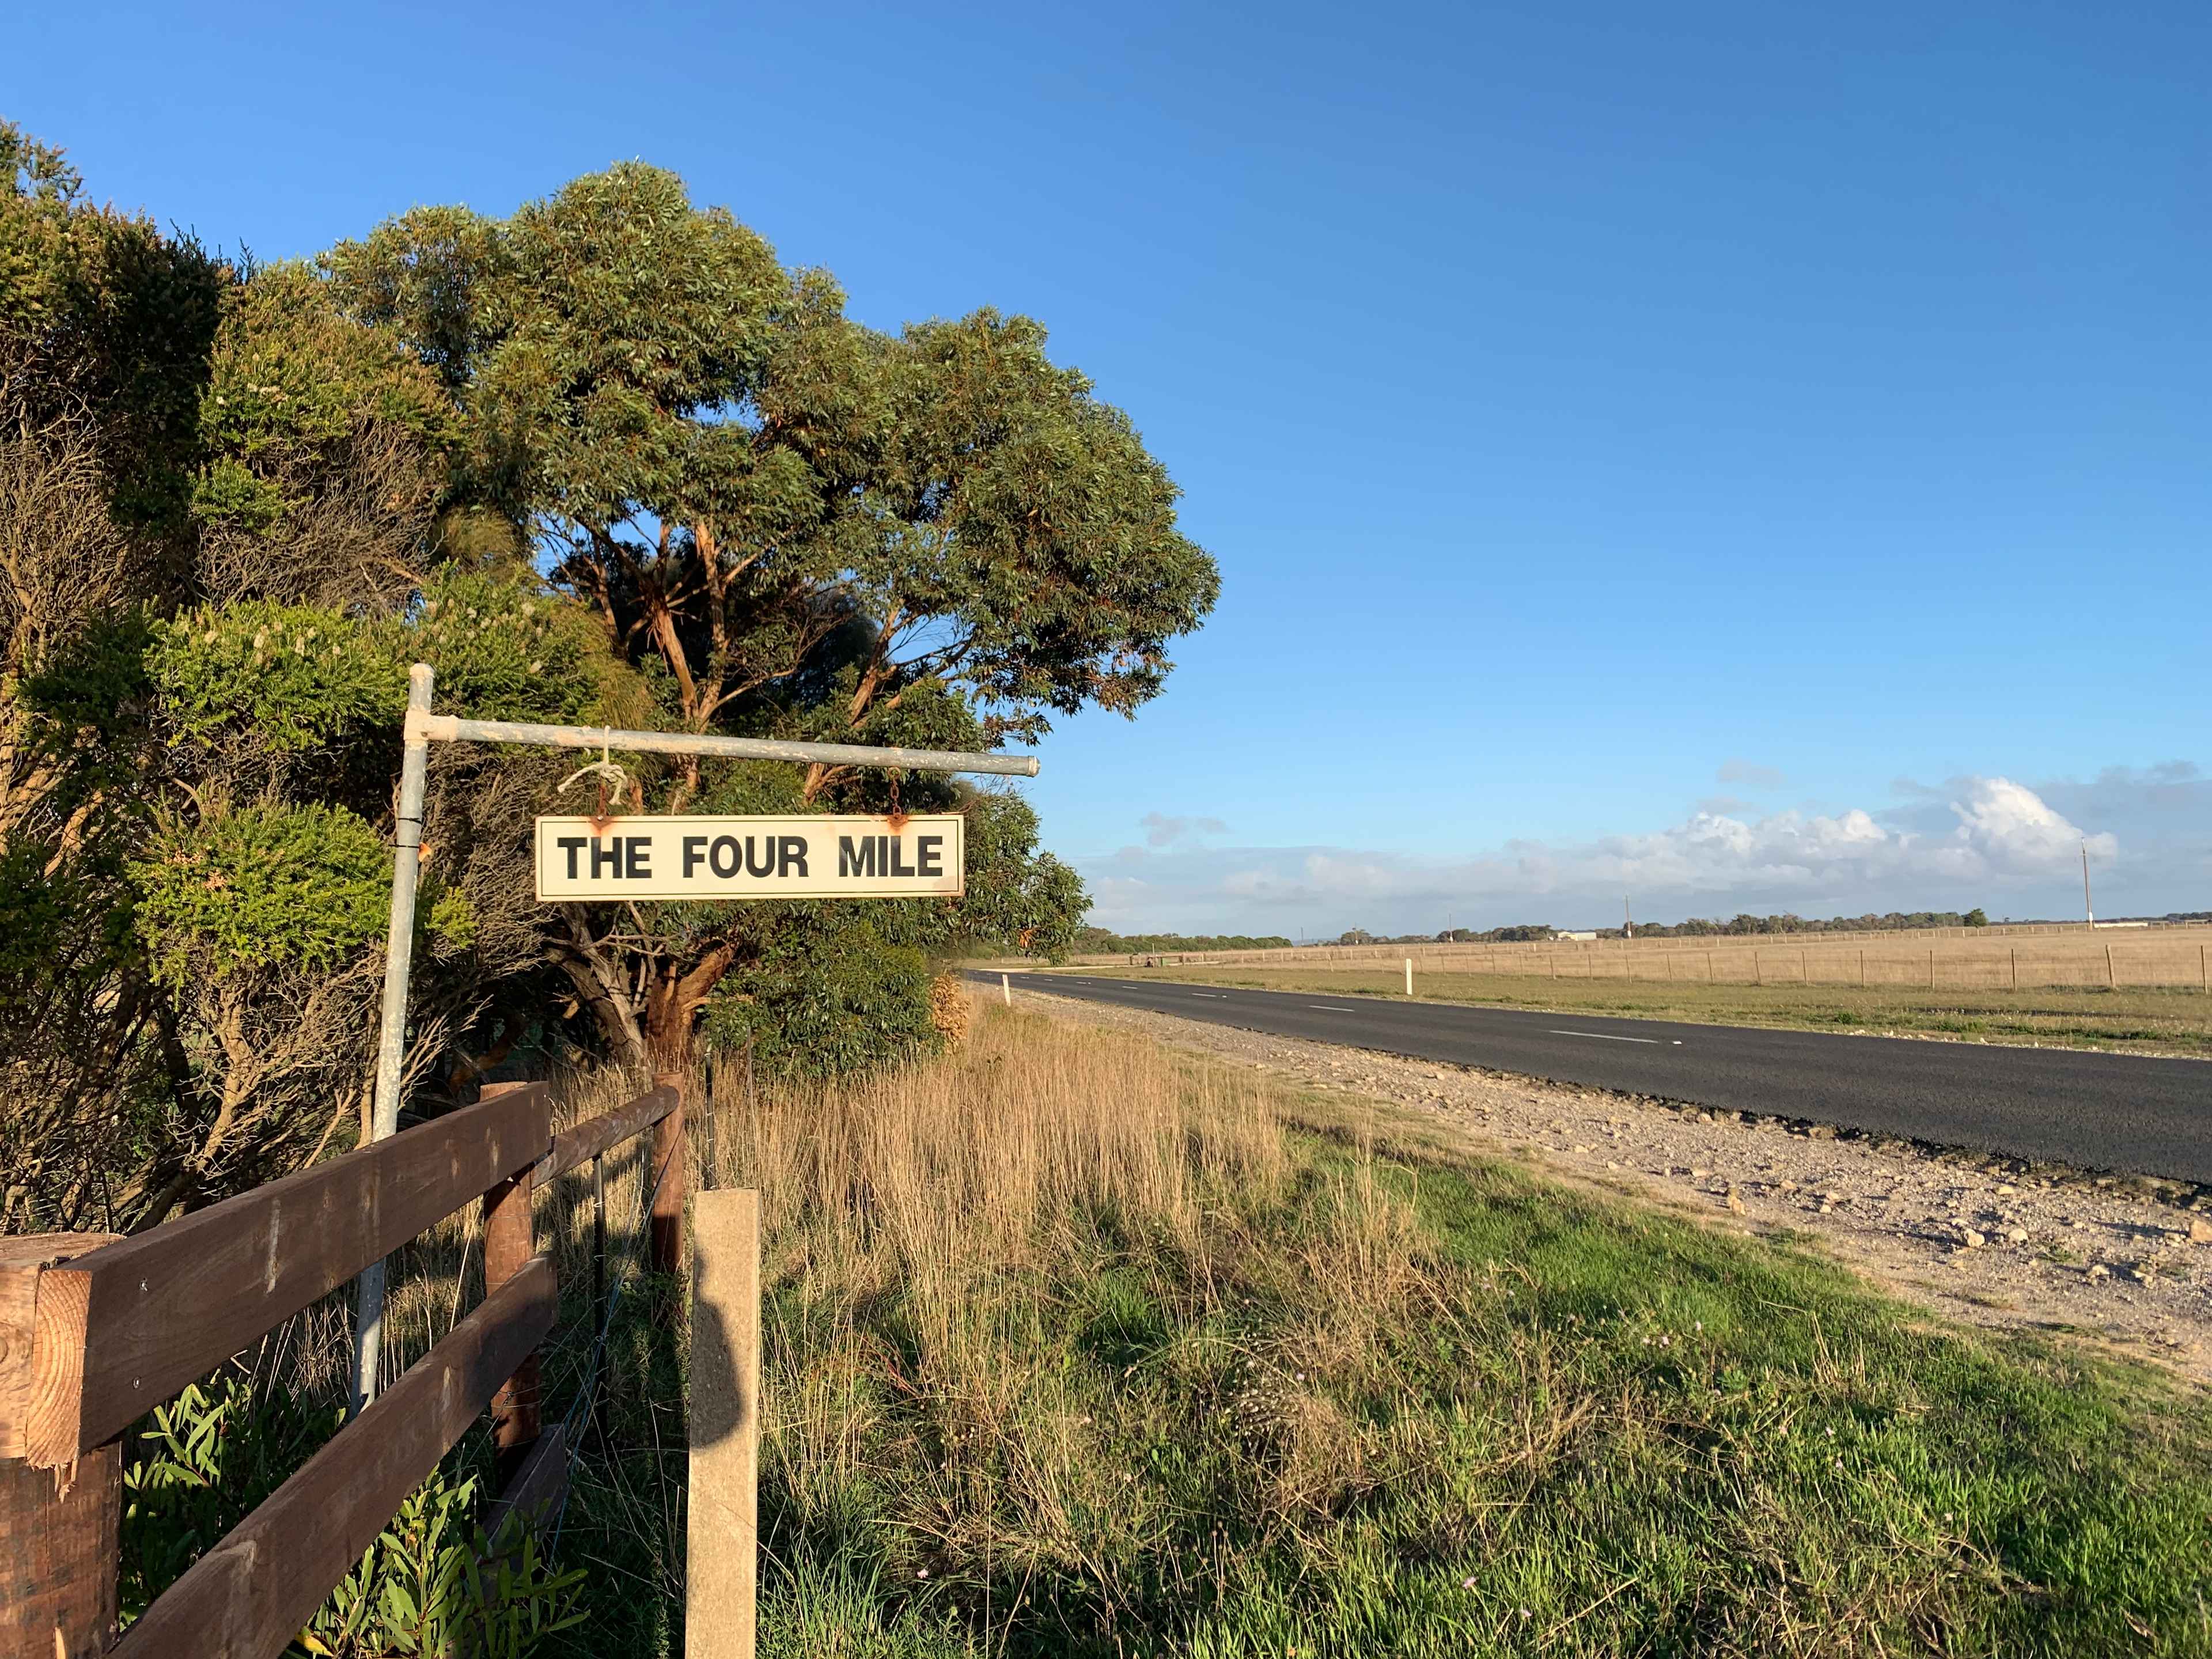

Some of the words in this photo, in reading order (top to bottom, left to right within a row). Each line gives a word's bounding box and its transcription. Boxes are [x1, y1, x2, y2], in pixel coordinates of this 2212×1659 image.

[557, 837, 652, 879] THE
[683, 835, 809, 878] FOUR
[839, 836, 943, 877] MILE
